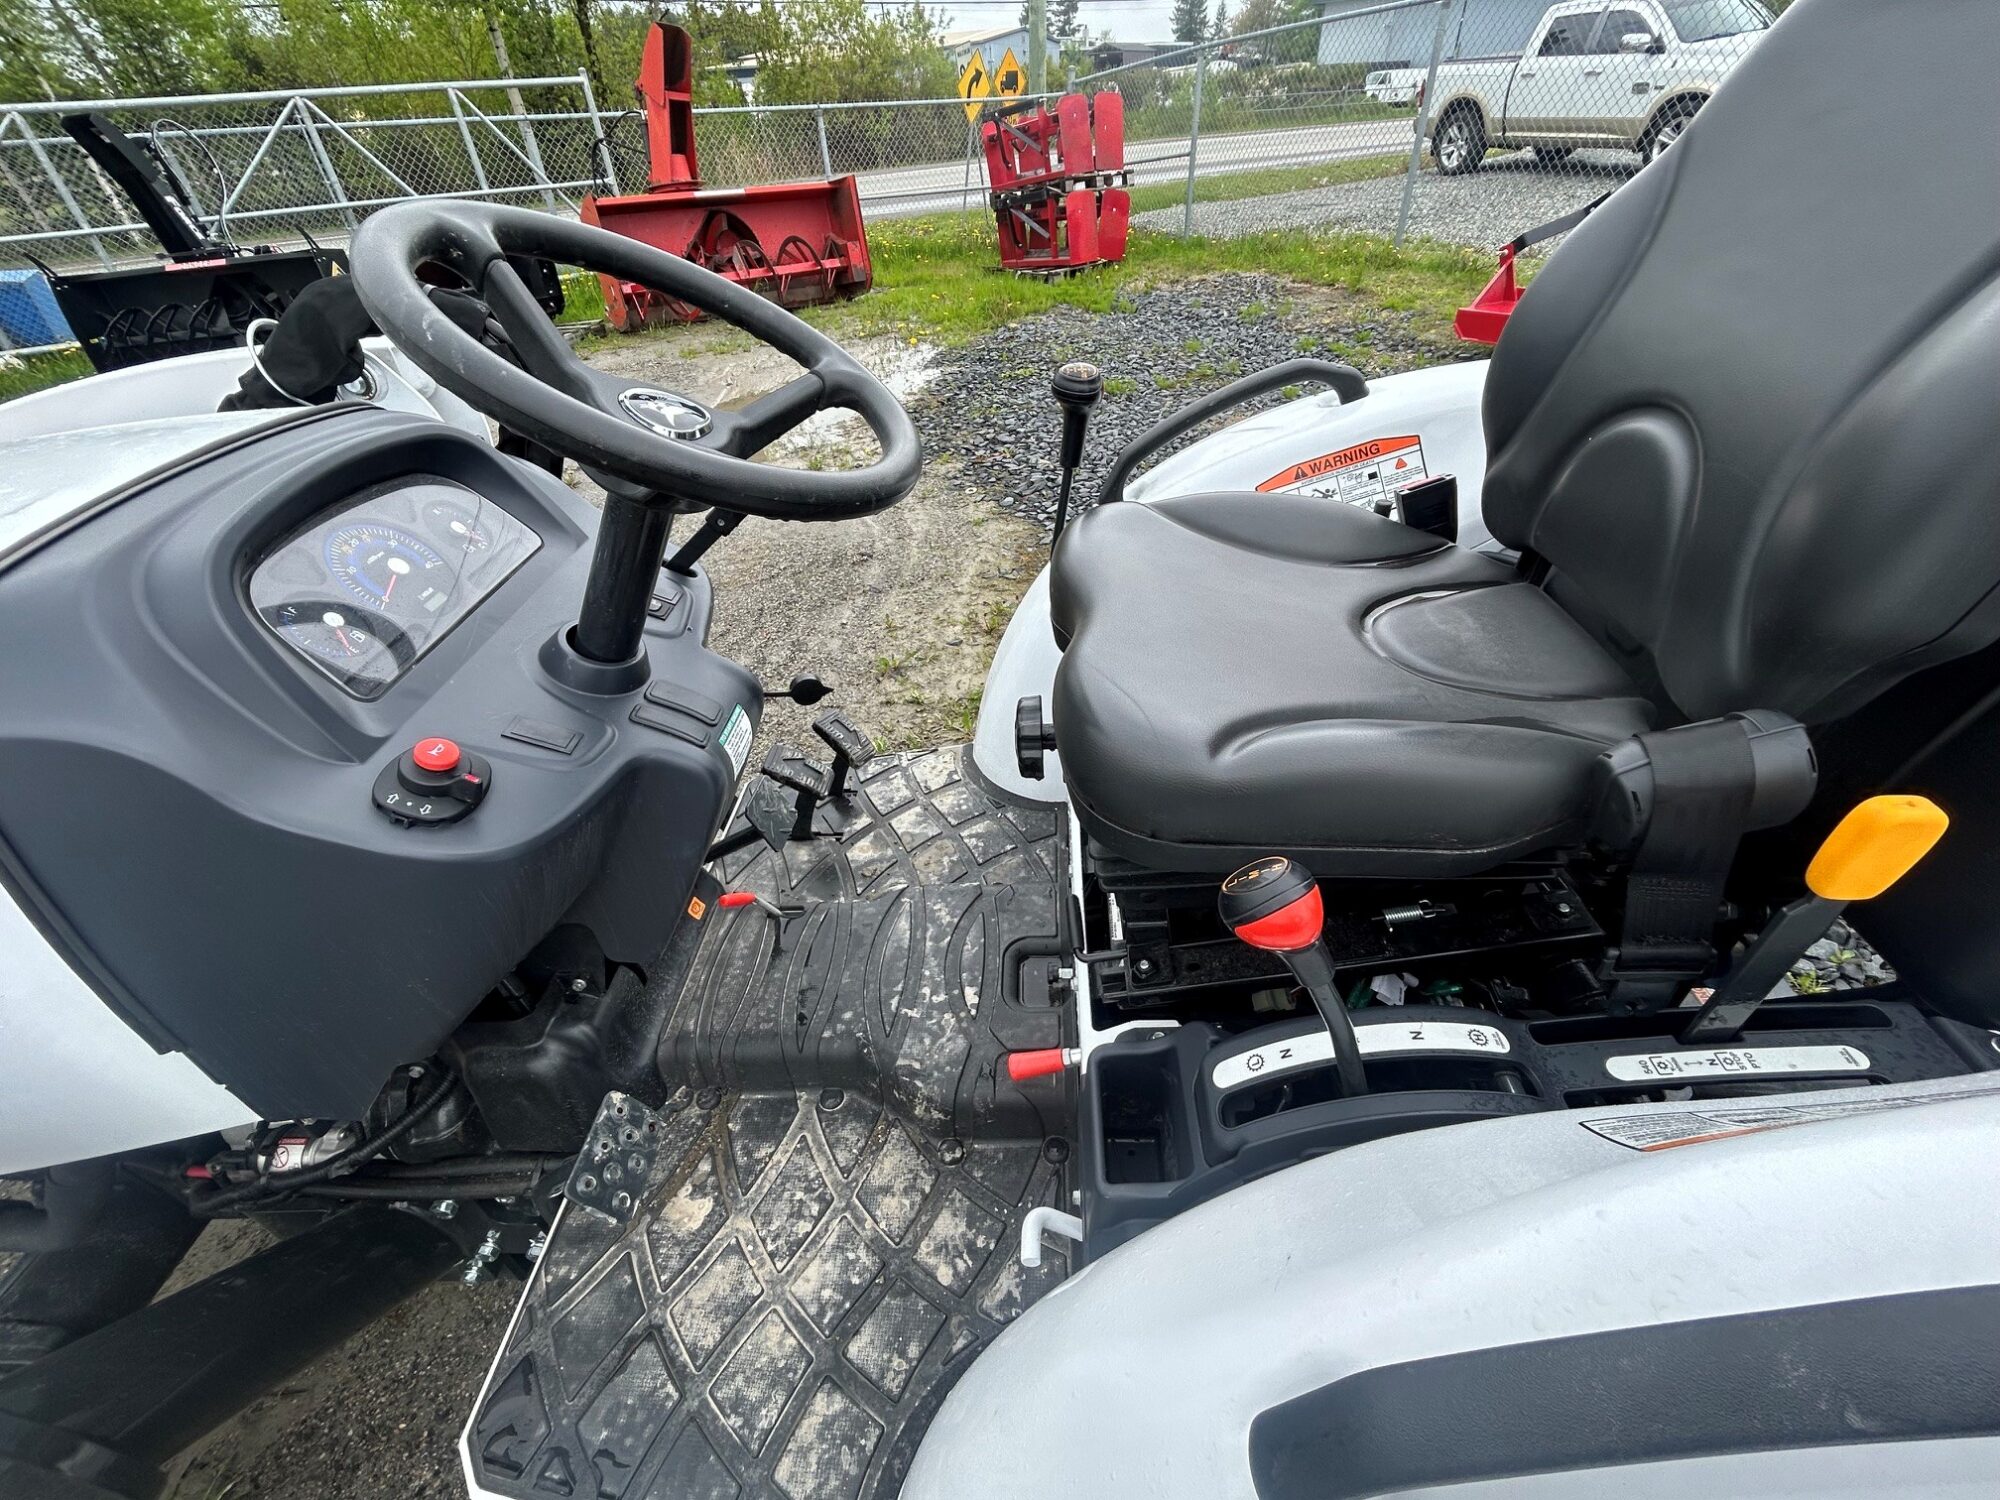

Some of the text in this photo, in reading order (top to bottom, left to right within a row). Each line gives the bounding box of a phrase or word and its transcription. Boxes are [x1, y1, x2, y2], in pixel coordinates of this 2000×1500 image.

[1309, 443, 1380, 474] WARNING
[347, 537, 360, 548] 20
[346, 565, 358, 575] 10
[287, 606, 297, 614] F
[1251, 1058, 1260, 1067] L
[1279, 1048, 1293, 1059] N
[1409, 1031, 1424, 1040] N
[1472, 1033, 1484, 1042] H
[1705, 1058, 1719, 1067] N
[1743, 1052, 1761, 1069] PTO
[1639, 1060, 1654, 1074] 540
